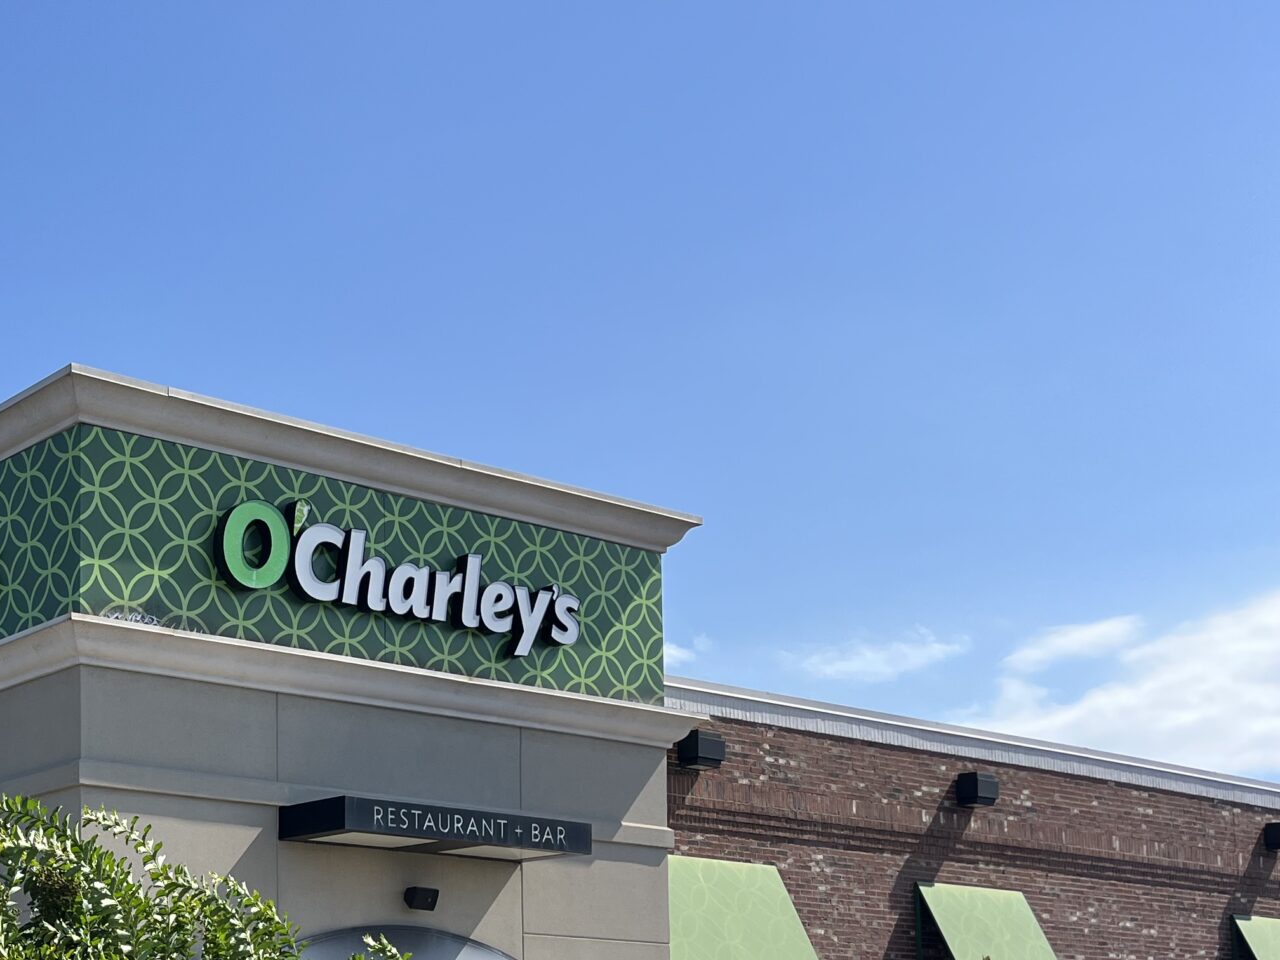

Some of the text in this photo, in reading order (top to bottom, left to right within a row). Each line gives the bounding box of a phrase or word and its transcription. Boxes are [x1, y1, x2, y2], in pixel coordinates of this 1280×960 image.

[223, 499, 581, 657] O'Charley's
[373, 806, 508, 839] RESTAURANT
[531, 823, 567, 845] BAR
